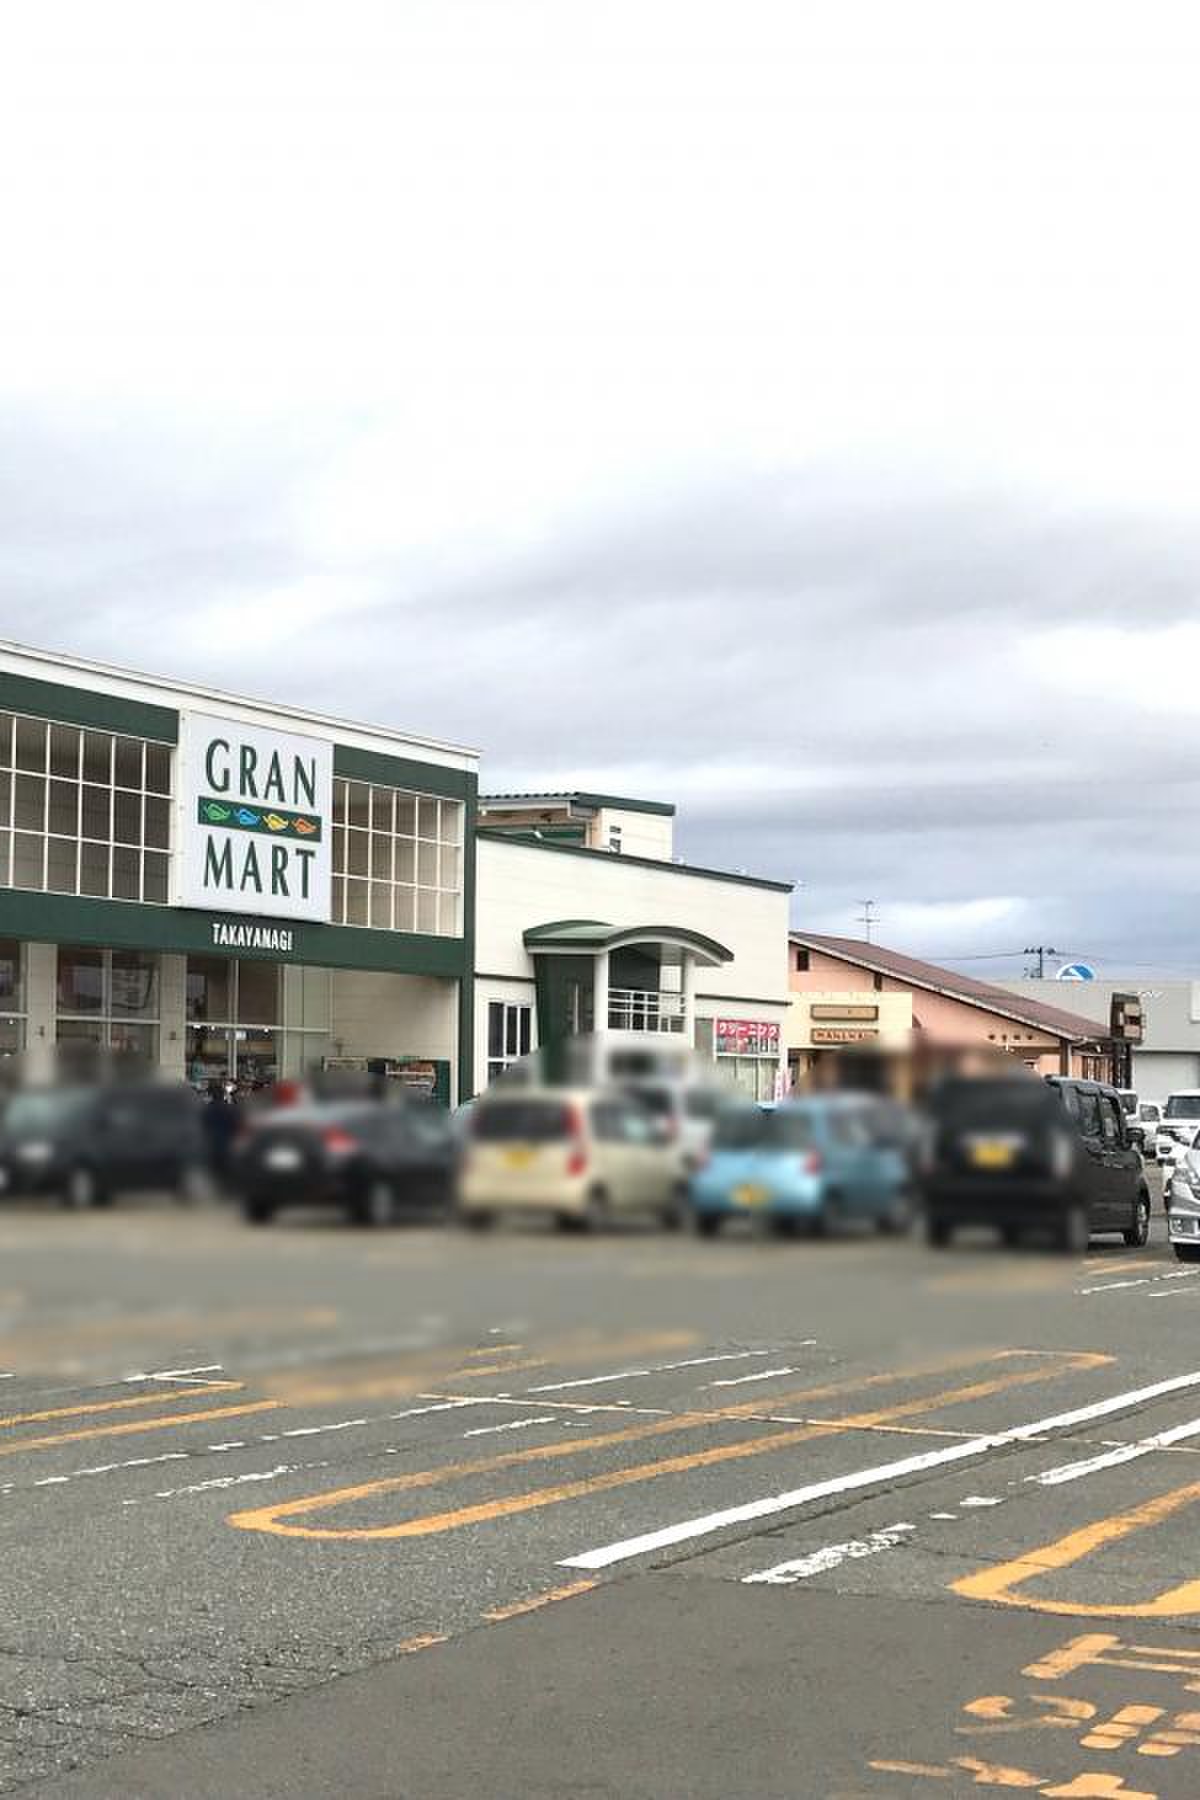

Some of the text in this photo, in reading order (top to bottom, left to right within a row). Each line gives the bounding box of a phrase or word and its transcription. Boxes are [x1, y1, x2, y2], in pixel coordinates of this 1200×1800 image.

[205, 739, 316, 807] GRAN
[203, 834, 316, 899] MART
[212, 923, 293, 951] TAKAYANAGI
